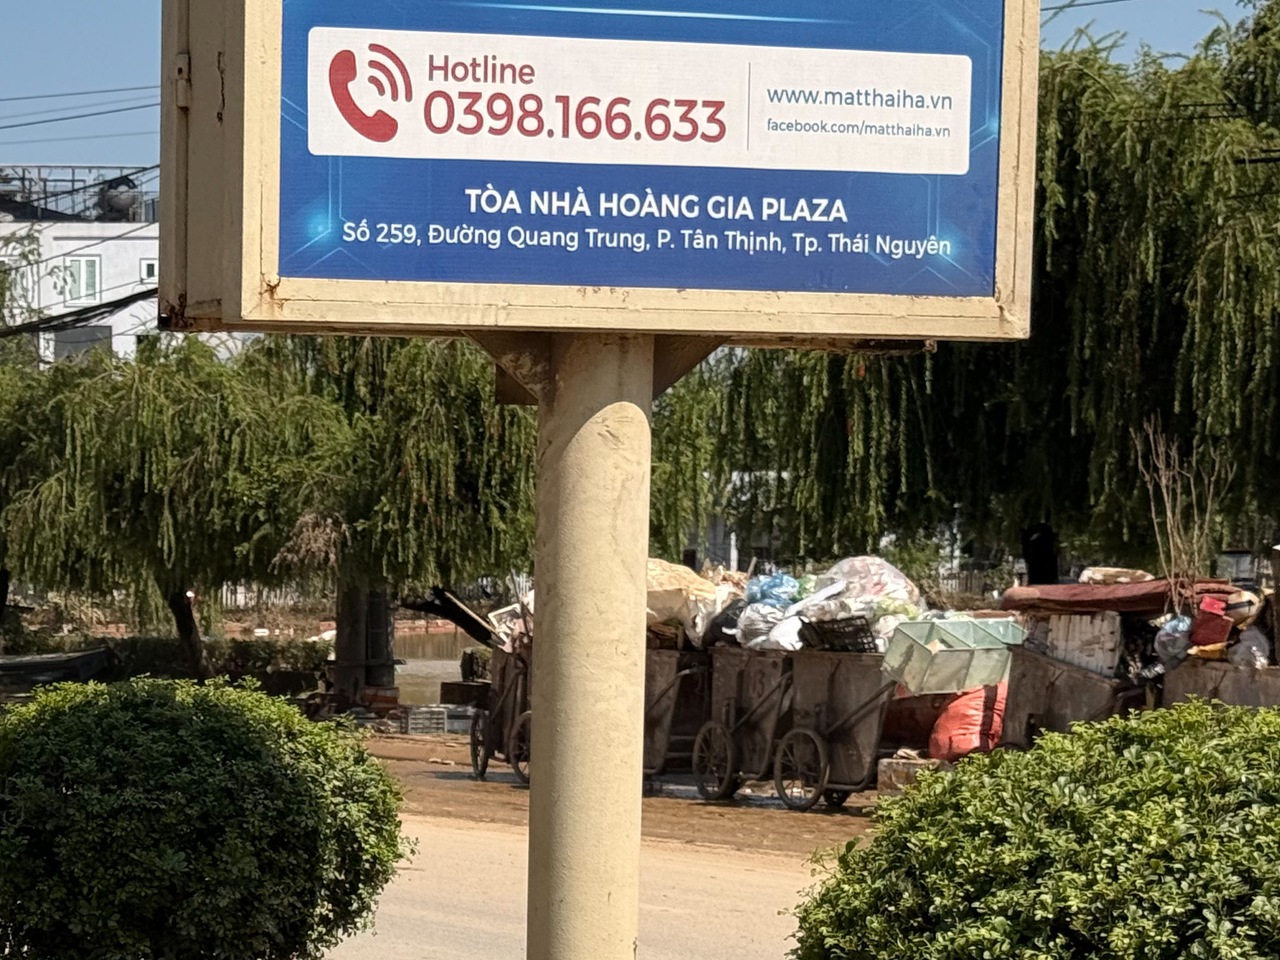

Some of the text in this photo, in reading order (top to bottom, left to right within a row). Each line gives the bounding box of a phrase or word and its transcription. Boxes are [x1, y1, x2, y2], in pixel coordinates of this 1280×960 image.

[428, 54, 536, 85] Hotline
[423, 90, 728, 143] 0398.166.633
[766, 88, 953, 110] www.matthaiha.vn
[766, 118, 951, 138] facebook.com/matthaiha.vn
[465, 182, 849, 222] TÒA NHÀ HOÀNG GIA PLAZA
[342, 218, 952, 260] Số 259, Đường Quang Trung, P. Tân Thịnh, Tp. Thái Nguyên
